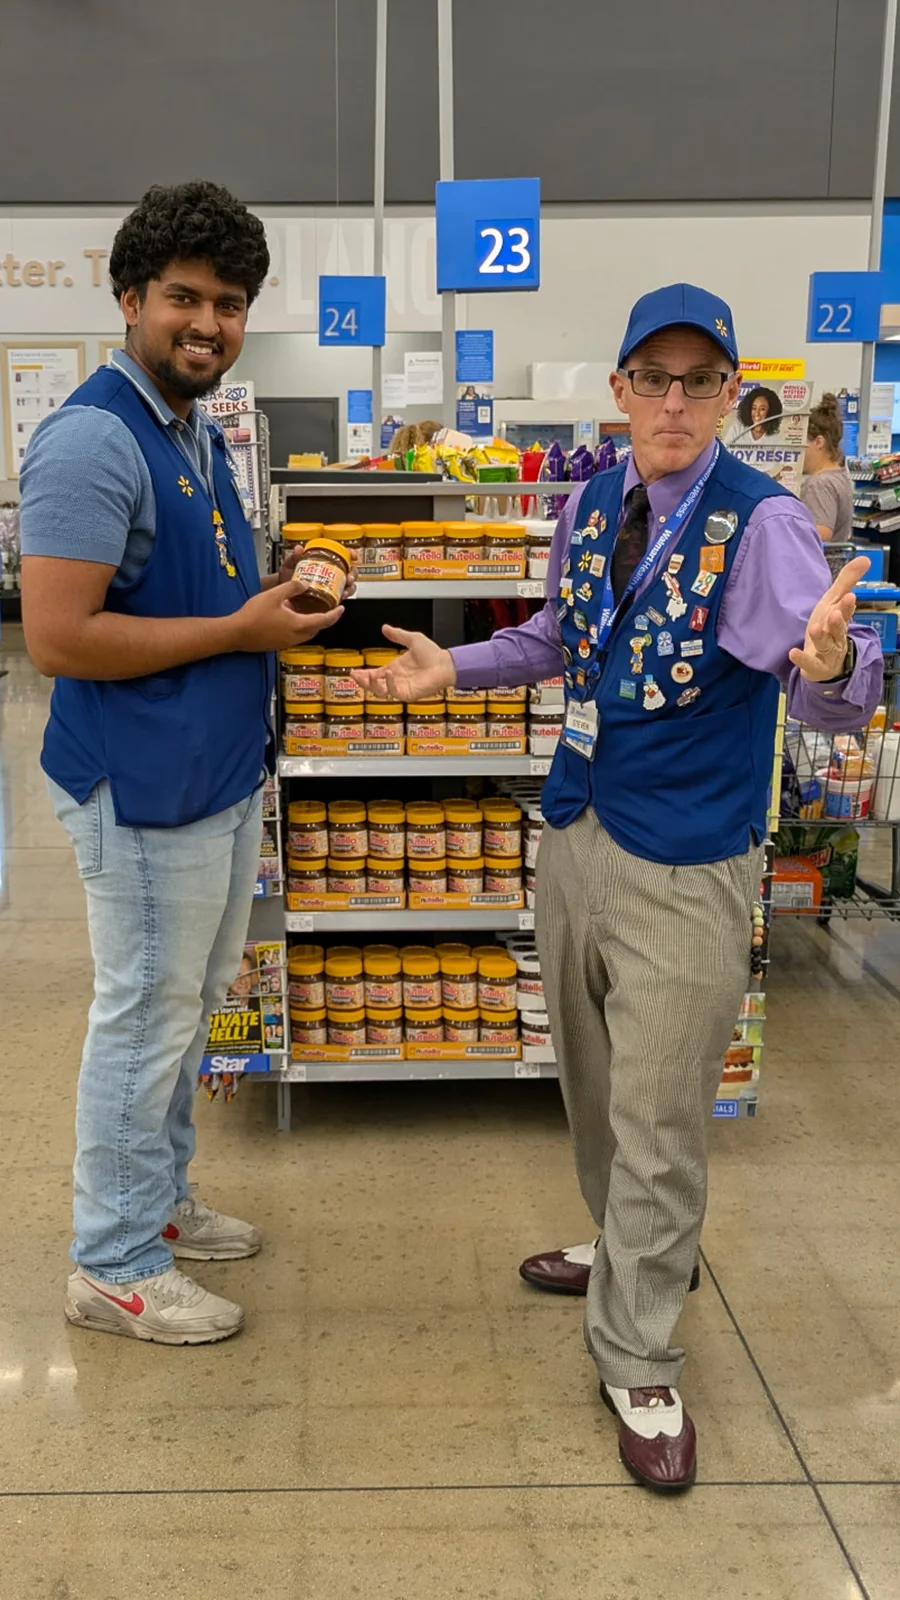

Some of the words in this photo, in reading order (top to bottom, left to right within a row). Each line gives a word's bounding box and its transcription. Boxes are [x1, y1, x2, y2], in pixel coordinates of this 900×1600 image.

[478, 227, 532, 274] 23
[0, 253, 74, 287] ter.
[324, 307, 358, 337] 24
[817, 304, 852, 333] 22
[224, 386, 247, 401] 250
[212, 401, 249, 413] SEEKS
[756, 451, 801, 462] RESET
[676, 485, 702, 518] Wellness
[646, 528, 673, 563] Walmart
[410, 552, 441, 561] nutella
[449, 552, 480, 561] nutella
[492, 552, 523, 561] nutella
[530, 551, 549, 560] nute
[297, 564, 336, 580] nutella
[632, 562, 651, 585] Health
[291, 679, 320, 688] nutella
[330, 679, 359, 689] nutella
[288, 728, 317, 737] nutella
[332, 728, 361, 738] nutella
[366, 728, 396, 737] nutella
[492, 729, 523, 737] nutella
[405, 988, 433, 996] nutella
[520, 983, 543, 992] utella
[209, 1025, 249, 1043] HELL!
[409, 1033, 438, 1041] nutella
[483, 1033, 512, 1041] nutella
[210, 1056, 250, 1072] Star
[712, 1104, 733, 1114] IALS
